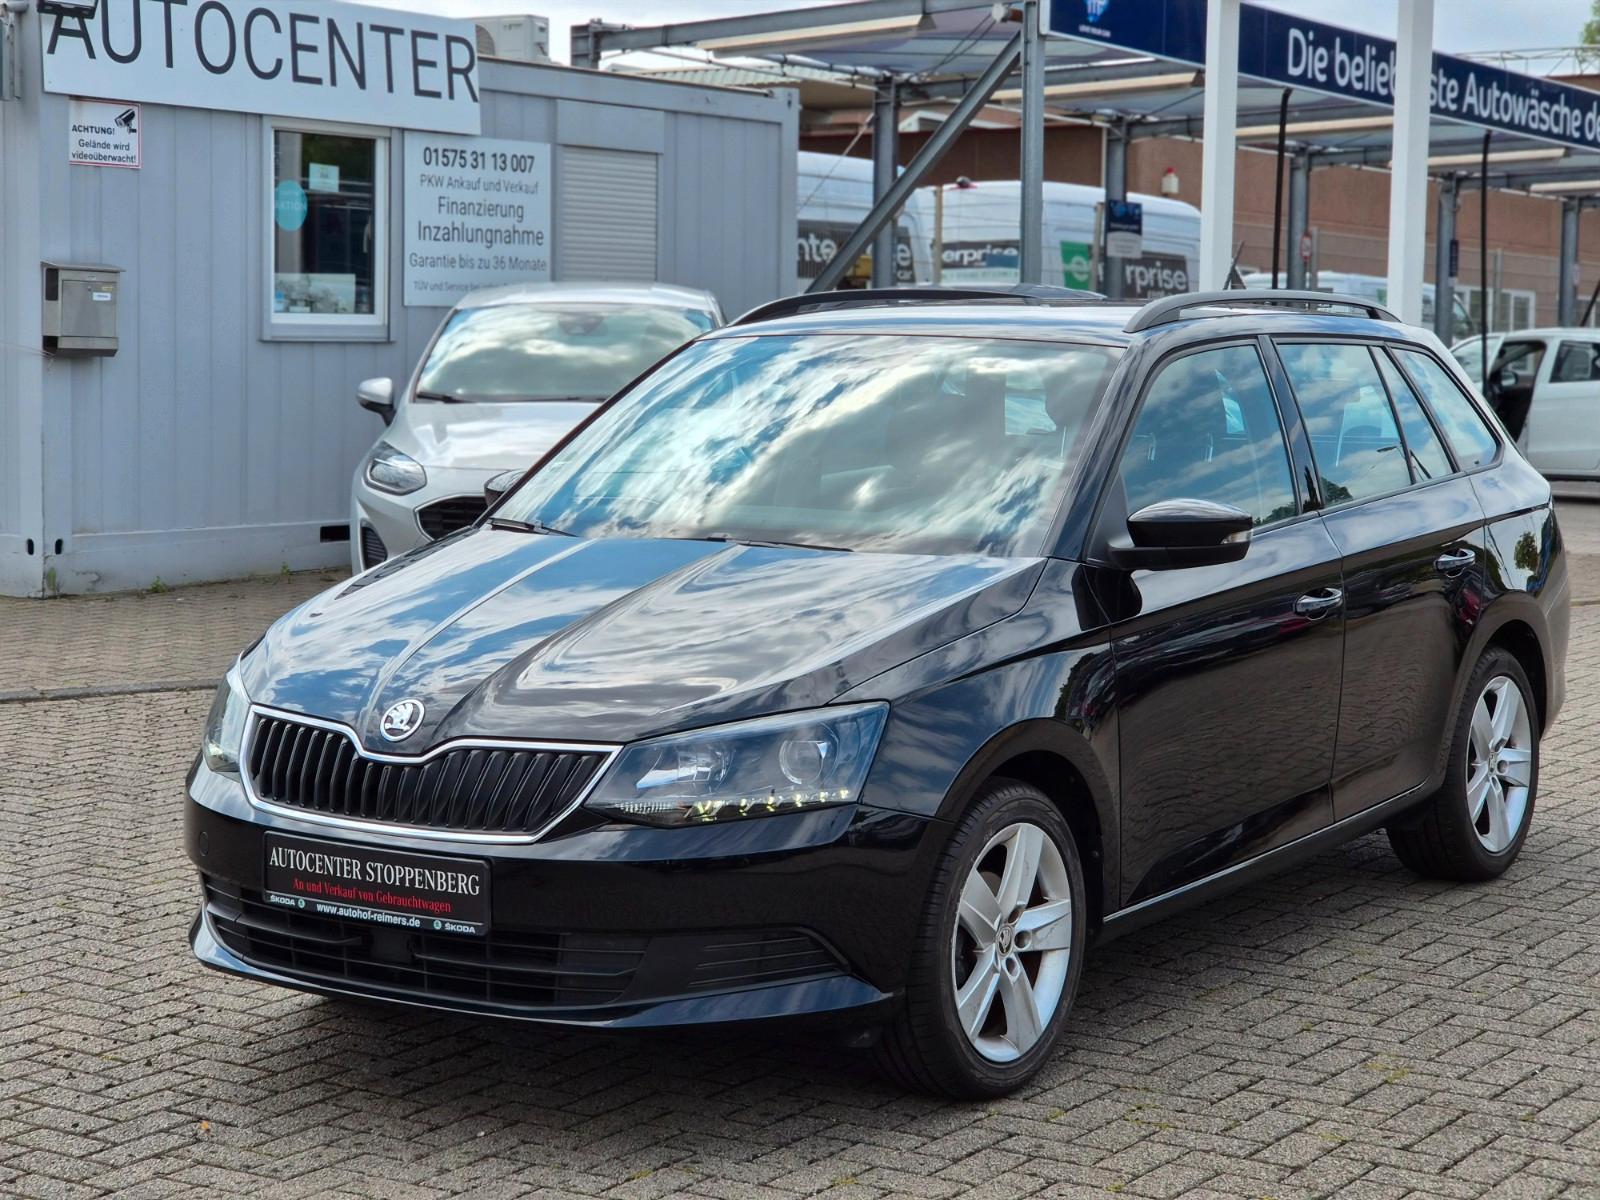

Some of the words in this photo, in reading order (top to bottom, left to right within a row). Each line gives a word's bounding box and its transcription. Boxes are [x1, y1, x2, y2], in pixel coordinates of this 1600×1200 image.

[47, 0, 479, 102] AUTOCENTER
[1288, 28, 1328, 82] Die
[1335, 37, 1458, 111] belieste
[1462, 72, 1581, 138] Autowäsche
[72, 125, 115, 135] ACHTUNG!
[71, 151, 136, 163] videoüberwacht!
[78, 139, 111, 150] Gelände
[113, 142, 130, 151] wird
[423, 146, 467, 169] 01575
[470, 150, 486, 170] 31
[491, 152, 508, 172] 13
[511, 154, 535, 173] 007
[420, 174, 444, 188] PKW
[447, 177, 480, 191] Ankauf
[483, 179, 501, 192] und
[503, 180, 539, 195] Verkauf
[438, 196, 524, 223] Finanzierung
[418, 220, 544, 249] Inzahlungnahme
[409, 252, 456, 268] Garantie
[459, 254, 474, 269] bis
[477, 258, 490, 270] zu
[492, 256, 505, 270] 36
[508, 257, 546, 271] Monate
[413, 280, 428, 291] TÜV
[430, 281, 443, 291] und
[1125, 260, 1187, 293] rprise
[269, 846, 362, 880] AUTOCENTER
[366, 861, 480, 896] STOPPENBERG
[293, 878, 304, 890] An
[306, 881, 322, 893] und
[324, 882, 357, 898] Verkauf
[357, 891, 373, 902] von
[376, 890, 452, 913] Gebrauchtwagen
[316, 903, 421, 928] www.autohof-reimers.de
